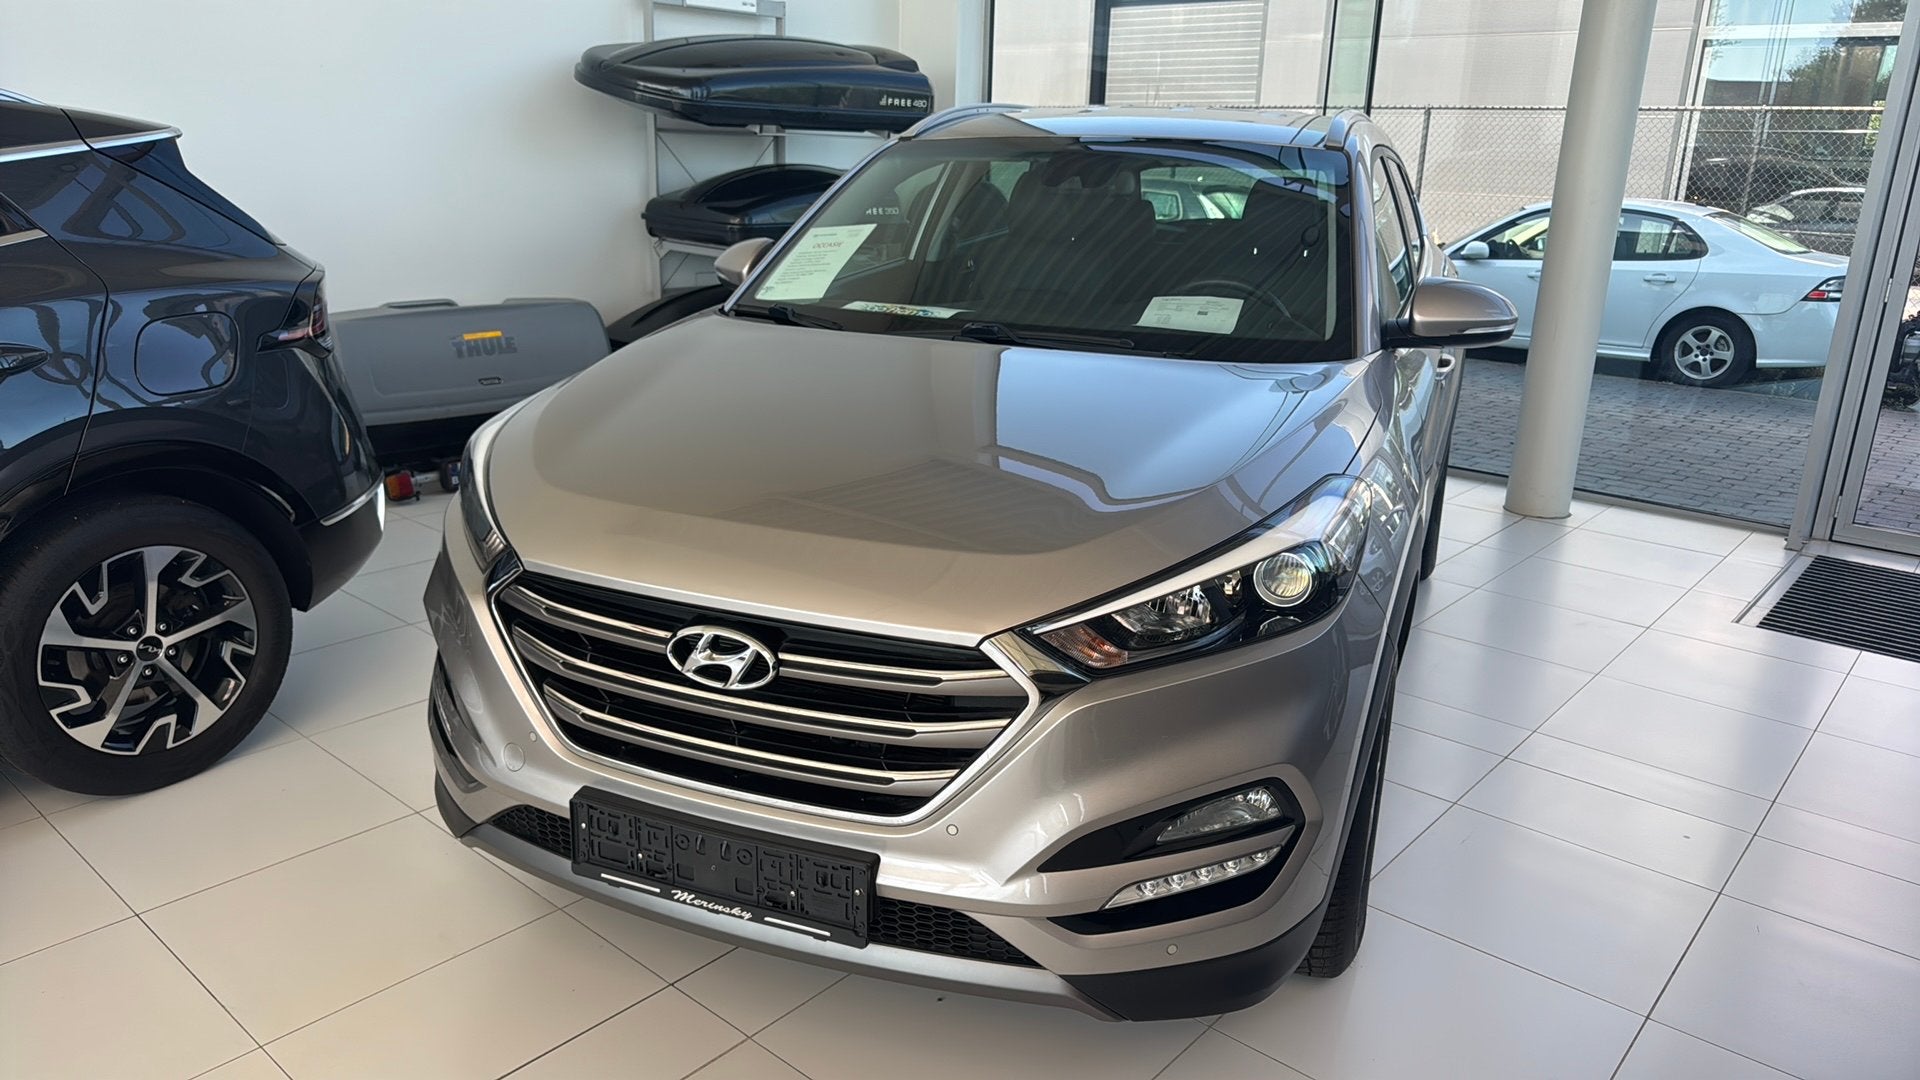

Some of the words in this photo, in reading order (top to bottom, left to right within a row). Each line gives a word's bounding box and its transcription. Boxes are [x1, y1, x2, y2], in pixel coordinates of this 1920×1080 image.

[887, 97, 912, 107] FREE
[912, 99, 928, 108] 480
[865, 207, 884, 216] REE
[451, 336, 518, 359] THULE
[670, 889, 753, 920] Merinsky
